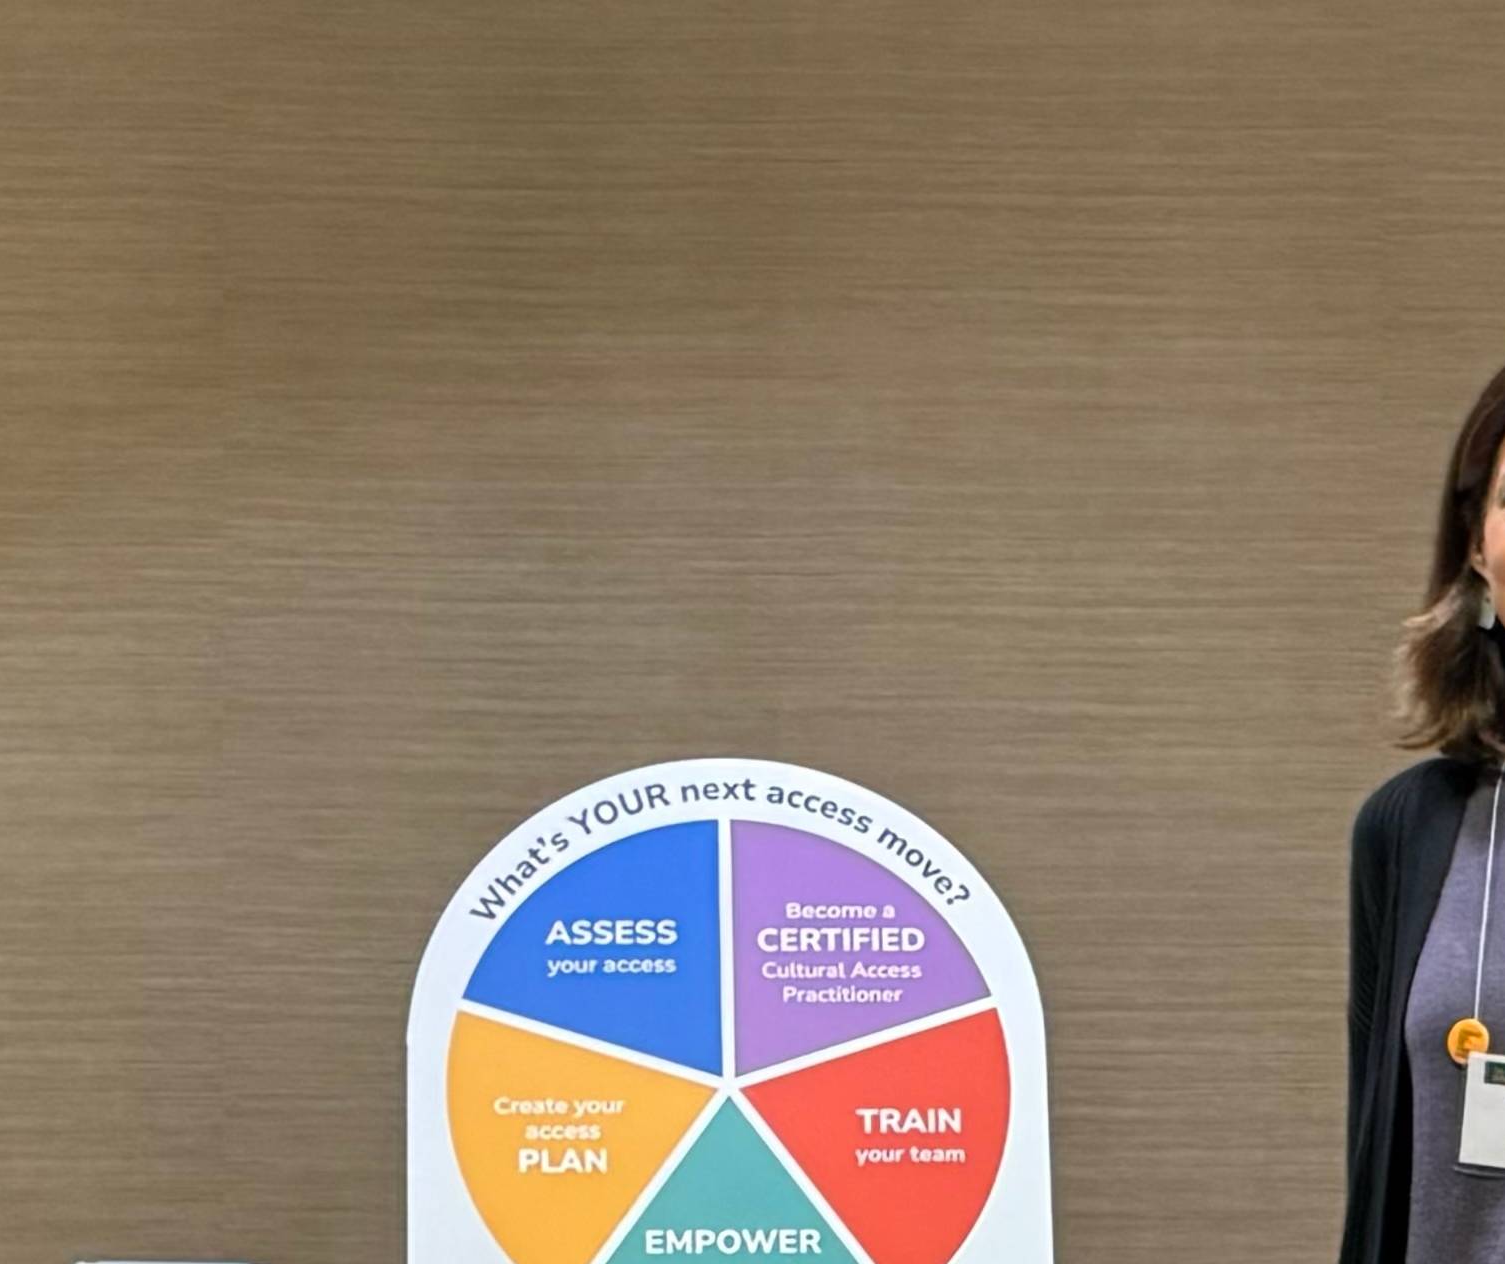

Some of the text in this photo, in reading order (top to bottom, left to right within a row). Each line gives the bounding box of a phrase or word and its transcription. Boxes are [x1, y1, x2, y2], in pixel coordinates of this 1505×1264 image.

[468, 777, 972, 924] What's YOUR next access move?
[785, 902, 896, 920] Become a
[545, 919, 678, 945] ASSESS
[756, 927, 926, 953] CERTIFIED
[547, 957, 677, 977] your access
[761, 961, 923, 980] Cultural Access
[782, 985, 904, 1004] Practitioner
[493, 1096, 625, 1119] Create your
[524, 1123, 602, 1141] access
[856, 1108, 962, 1134] TRAIN
[517, 1148, 608, 1174] PLAN
[855, 1146, 966, 1166] your team
[644, 1228, 822, 1255] EMPOWER
